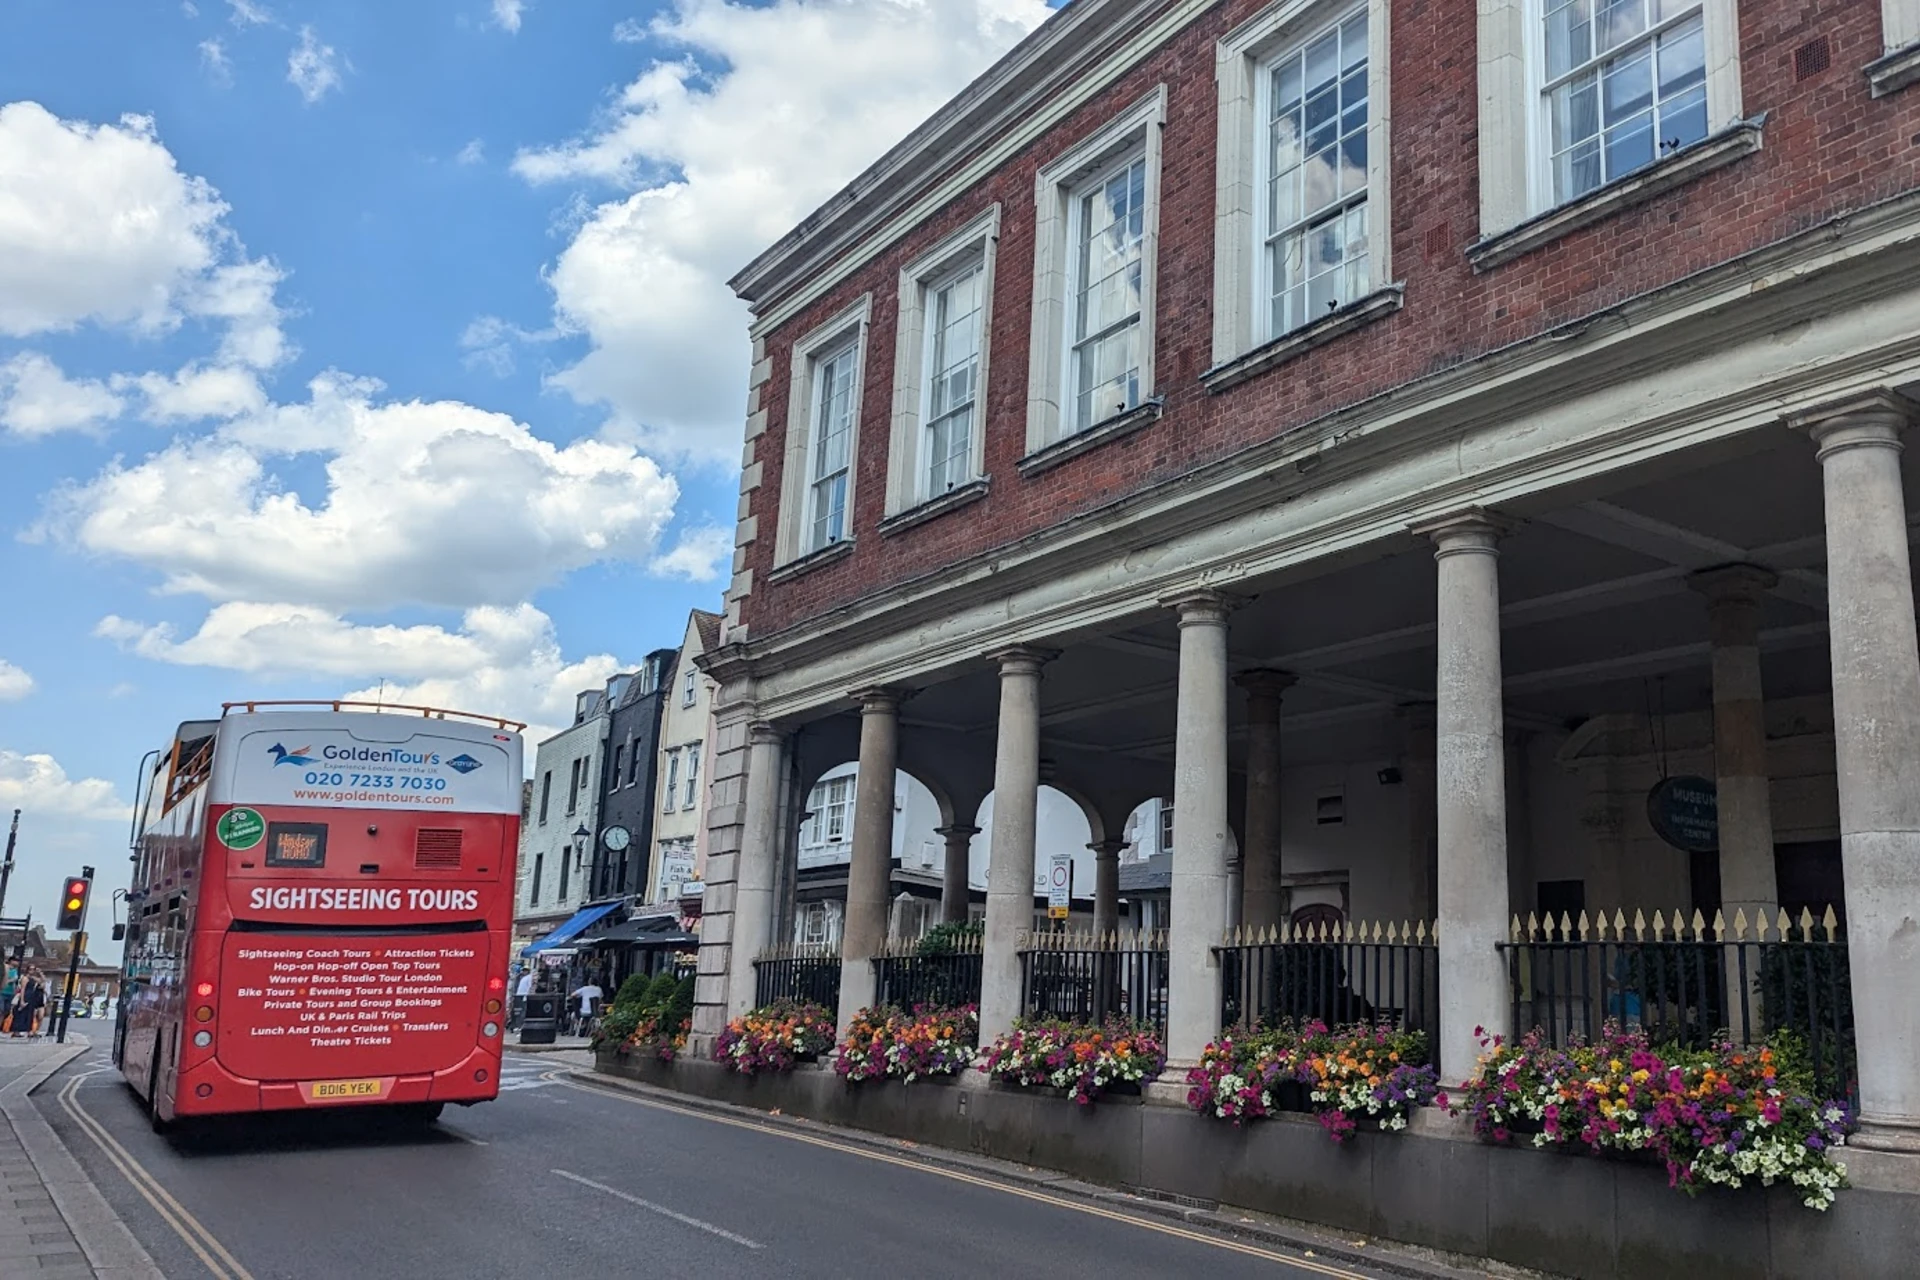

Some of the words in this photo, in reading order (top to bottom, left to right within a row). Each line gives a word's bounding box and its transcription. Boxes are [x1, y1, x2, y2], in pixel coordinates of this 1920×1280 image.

[324, 763, 366, 771] Experience
[368, 765, 396, 773] London
[305, 772, 343, 786] 020
[350, 774, 394, 788] 7233
[400, 776, 446, 791] 7030
[293, 789, 454, 805] www.goldentours.com
[1672, 787, 1717, 806] MUSEUM
[1671, 814, 1717, 829] INFORMATIO
[249, 887, 401, 910] SIGHTSEEING
[407, 889, 479, 910] TOURS
[238, 949, 304, 959] Sightseeing
[306, 949, 340, 958] Coach
[342, 949, 371, 958] Tours
[384, 949, 437, 958] Attraction
[440, 949, 475, 958] Tickets
[273, 962, 315, 972] Hop-on
[317, 961, 359, 971] Hop-off
[360, 962, 389, 971] Open
[392, 962, 411, 971] Top
[413, 962, 441, 970] Tours
[269, 975, 309, 984] Warner
[311, 975, 339, 983] Bros.
[341, 974, 376, 983] Studio
[379, 974, 402, 983] Tour
[404, 973, 443, 982] London
[238, 988, 263, 997] Bike
[266, 988, 296, 997] Tours
[309, 986, 352, 997] Evening
[355, 987, 384, 995] Tours
[385, 987, 393, 995] &
[396, 986, 468, 994] Entertainment
[264, 1000, 303, 1009] Private
[306, 1000, 335, 1009] Tours
[337, 999, 358, 1008] and
[360, 999, 393, 1008] Group
[395, 998, 443, 1007] Bookings
[300, 1013, 316, 1021] UK
[318, 1012, 326, 1021] &
[328, 1012, 356, 1021] Paris
[358, 1011, 378, 1020] Rail
[381, 1011, 407, 1020] Trips
[251, 1027, 285, 1036] Lunch
[287, 1026, 310, 1035] And
[350, 1024, 390, 1033] Cruises
[403, 1022, 449, 1031] Transfers
[310, 1038, 352, 1047] Theatre
[354, 1036, 392, 1045] Tickets
[319, 1084, 346, 1095] BD16
[350, 1082, 374, 1094] YEK
